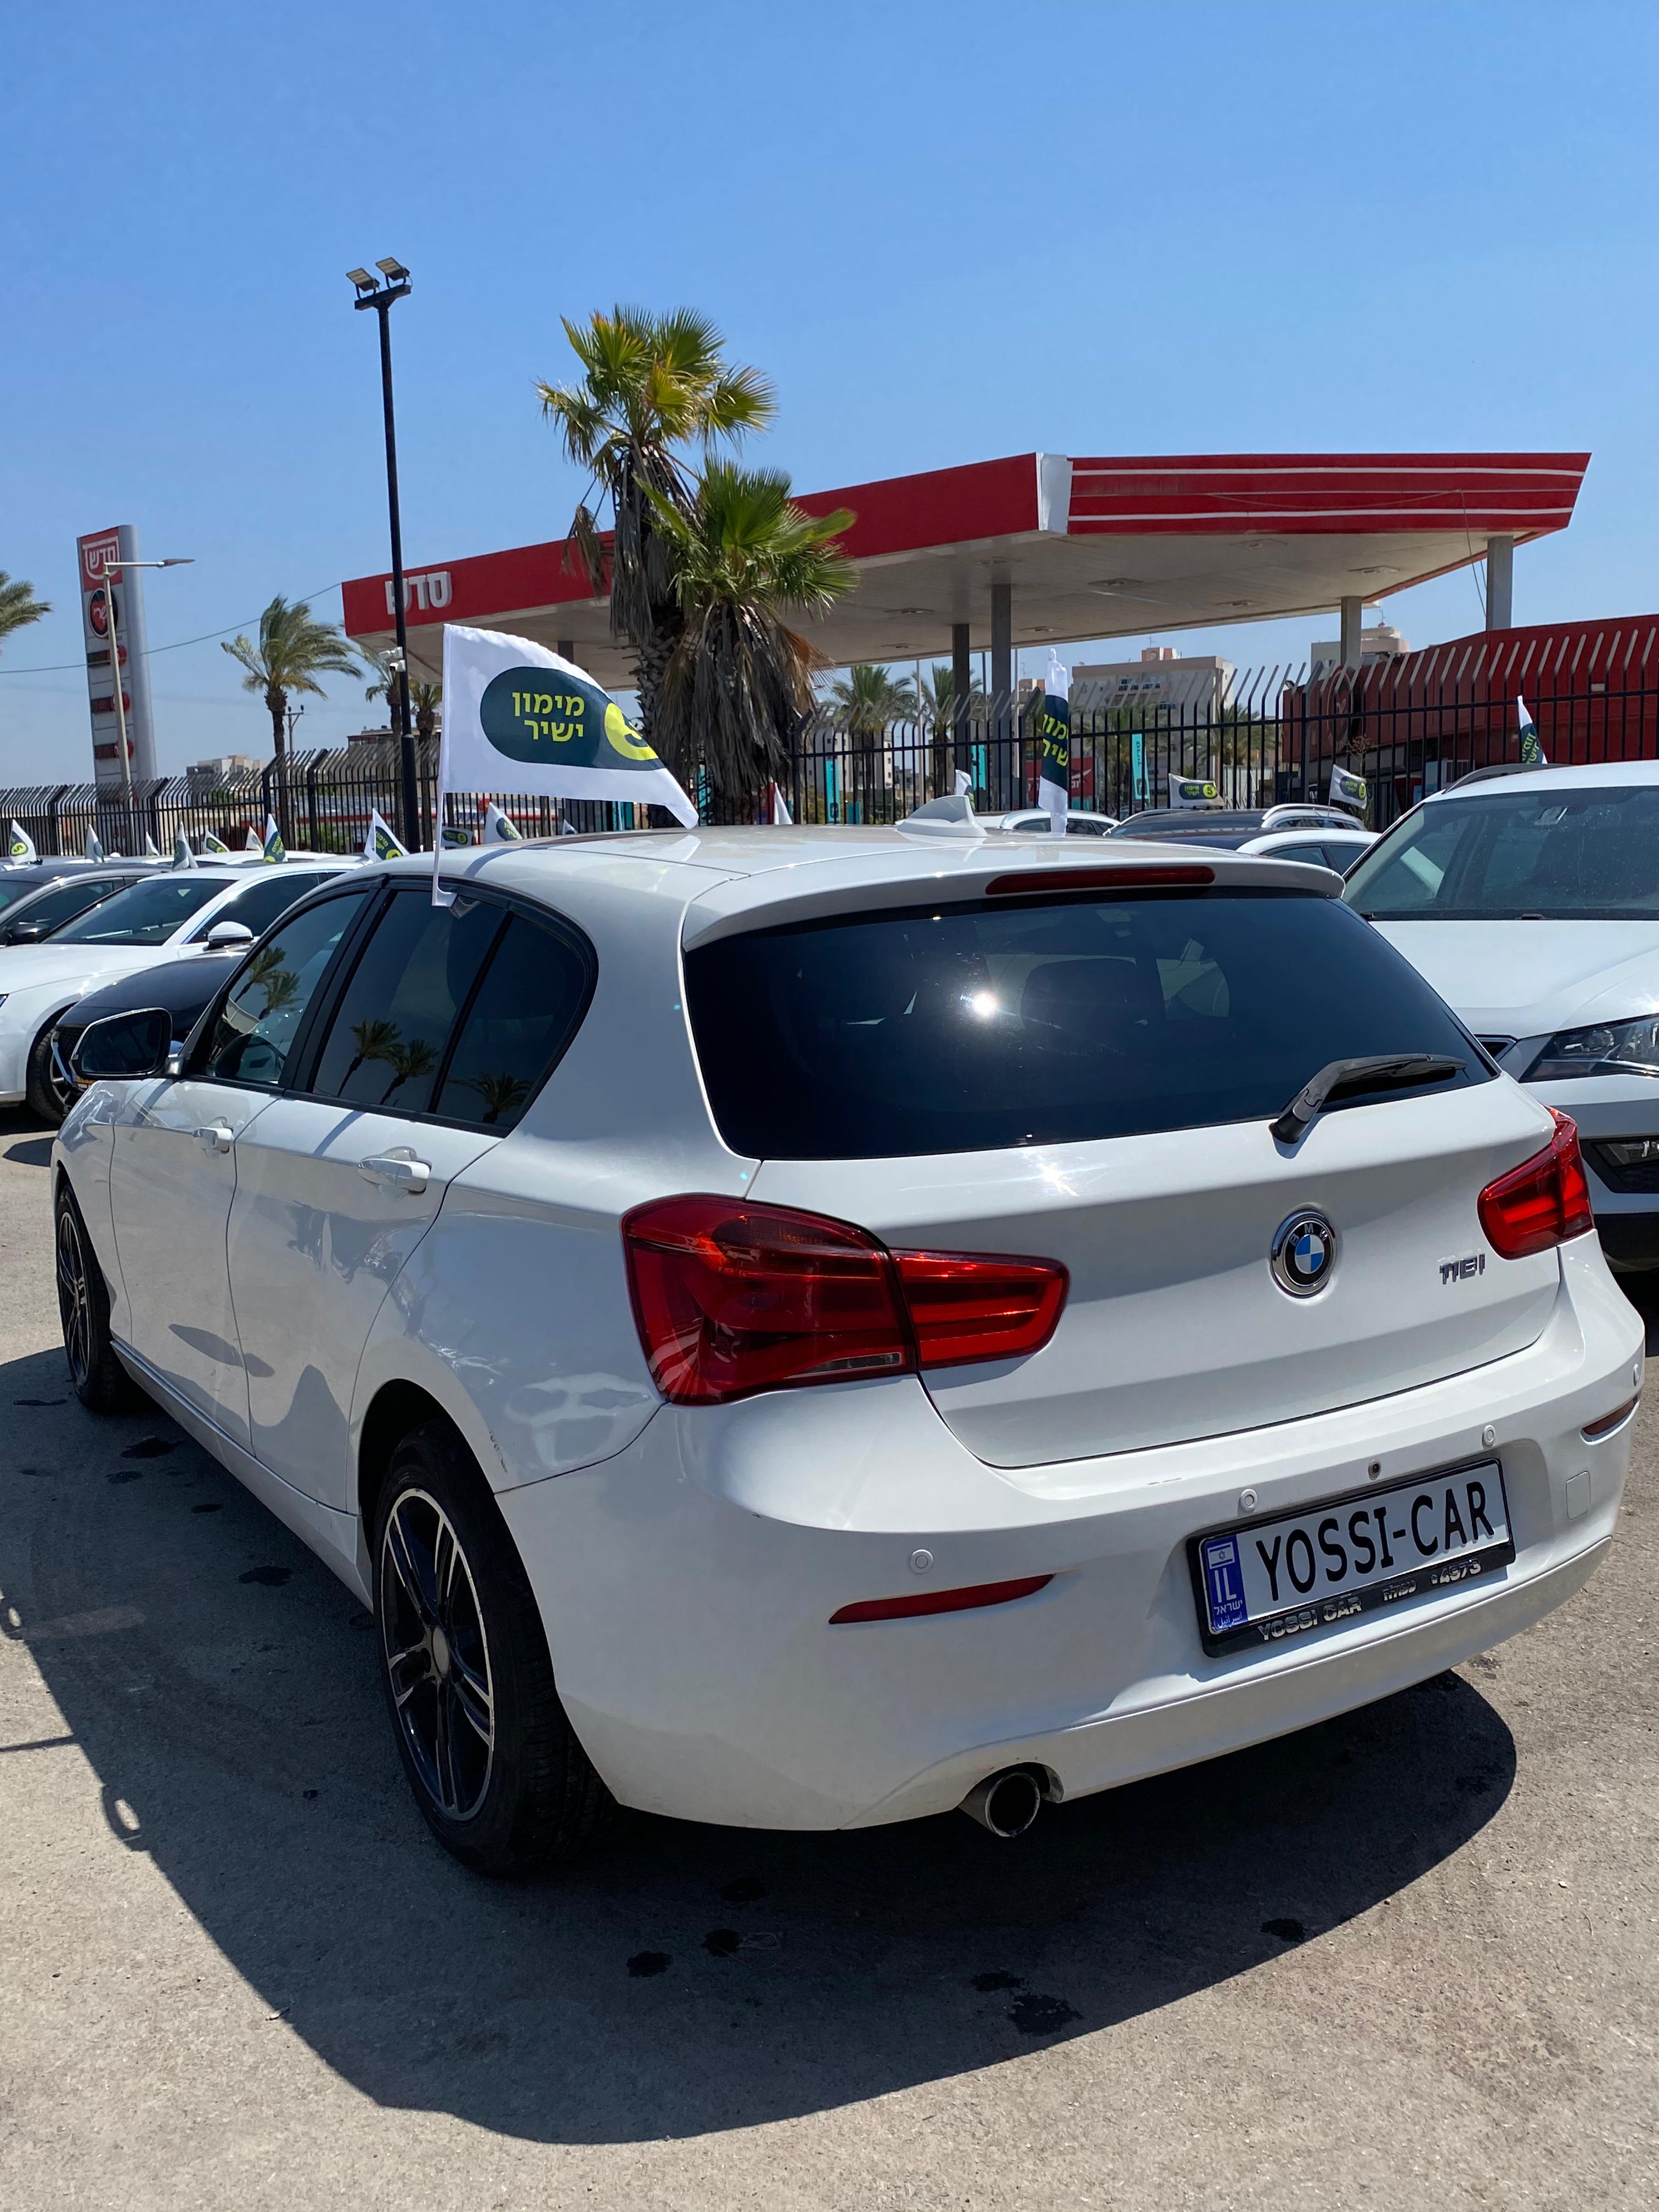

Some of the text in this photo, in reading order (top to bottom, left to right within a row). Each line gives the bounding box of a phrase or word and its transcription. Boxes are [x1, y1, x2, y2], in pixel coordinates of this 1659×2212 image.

[512, 691, 585, 717] מימון
[524, 719, 584, 742] ישיר
[1207, 786, 1213, 795] 5
[1289, 1223, 1329, 1246] BMW
[1256, 1481, 1494, 1601] YOSSI-CAR
[1214, 1567, 1237, 1603] IL
[1214, 1599, 1243, 1615] ישראל
[1257, 1609, 1318, 1640] YOSSI
[1323, 1596, 1362, 1621] CAR
